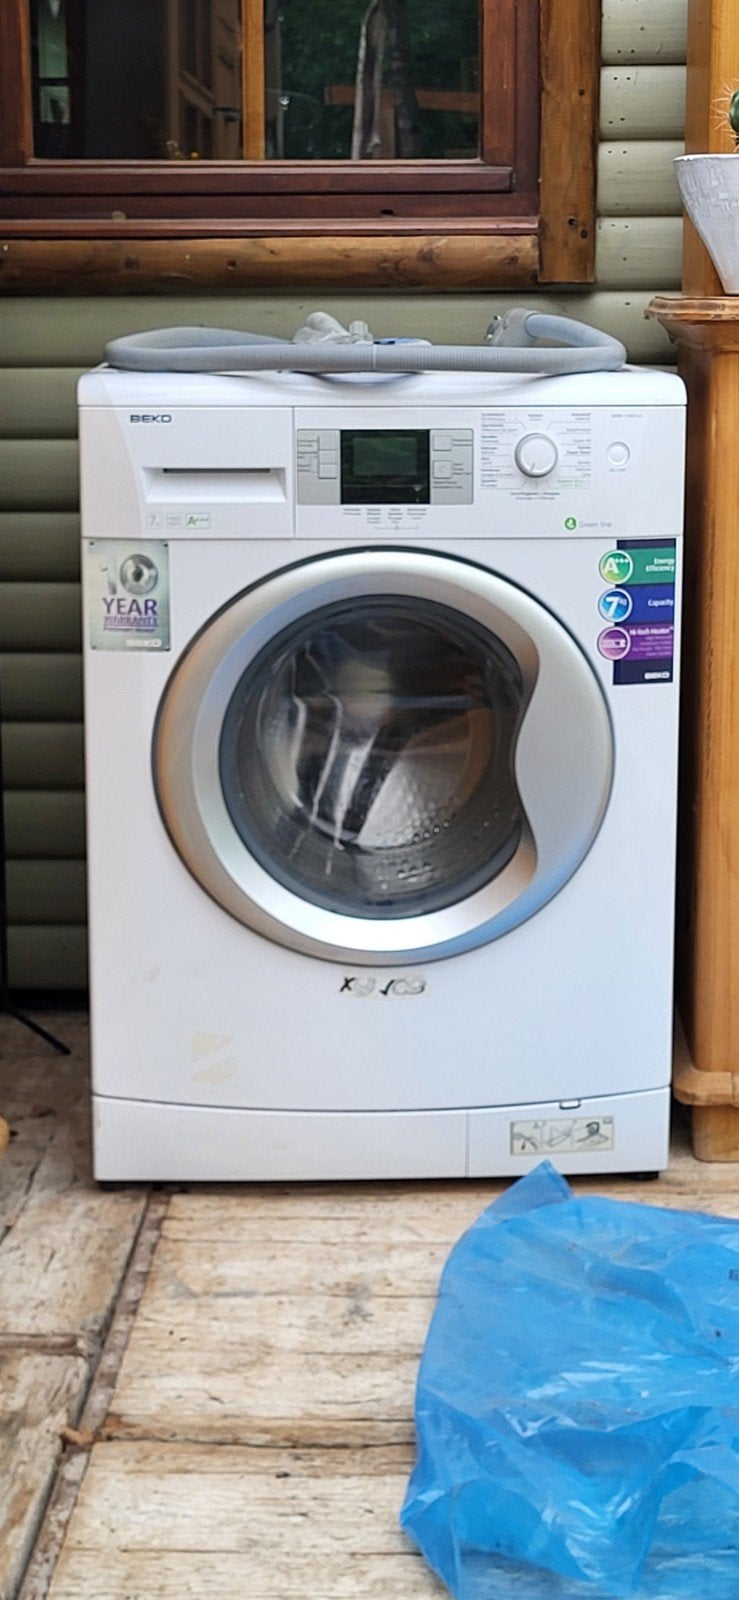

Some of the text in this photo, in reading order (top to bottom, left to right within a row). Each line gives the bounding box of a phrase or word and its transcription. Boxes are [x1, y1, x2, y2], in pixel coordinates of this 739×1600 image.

[130, 414, 172, 423] BEKO
[603, 557, 630, 574] A+++
[653, 557, 675, 567] Energy
[645, 564, 675, 573] Efficiency
[102, 597, 158, 616] YEAR
[647, 598, 674, 608] Capacity
